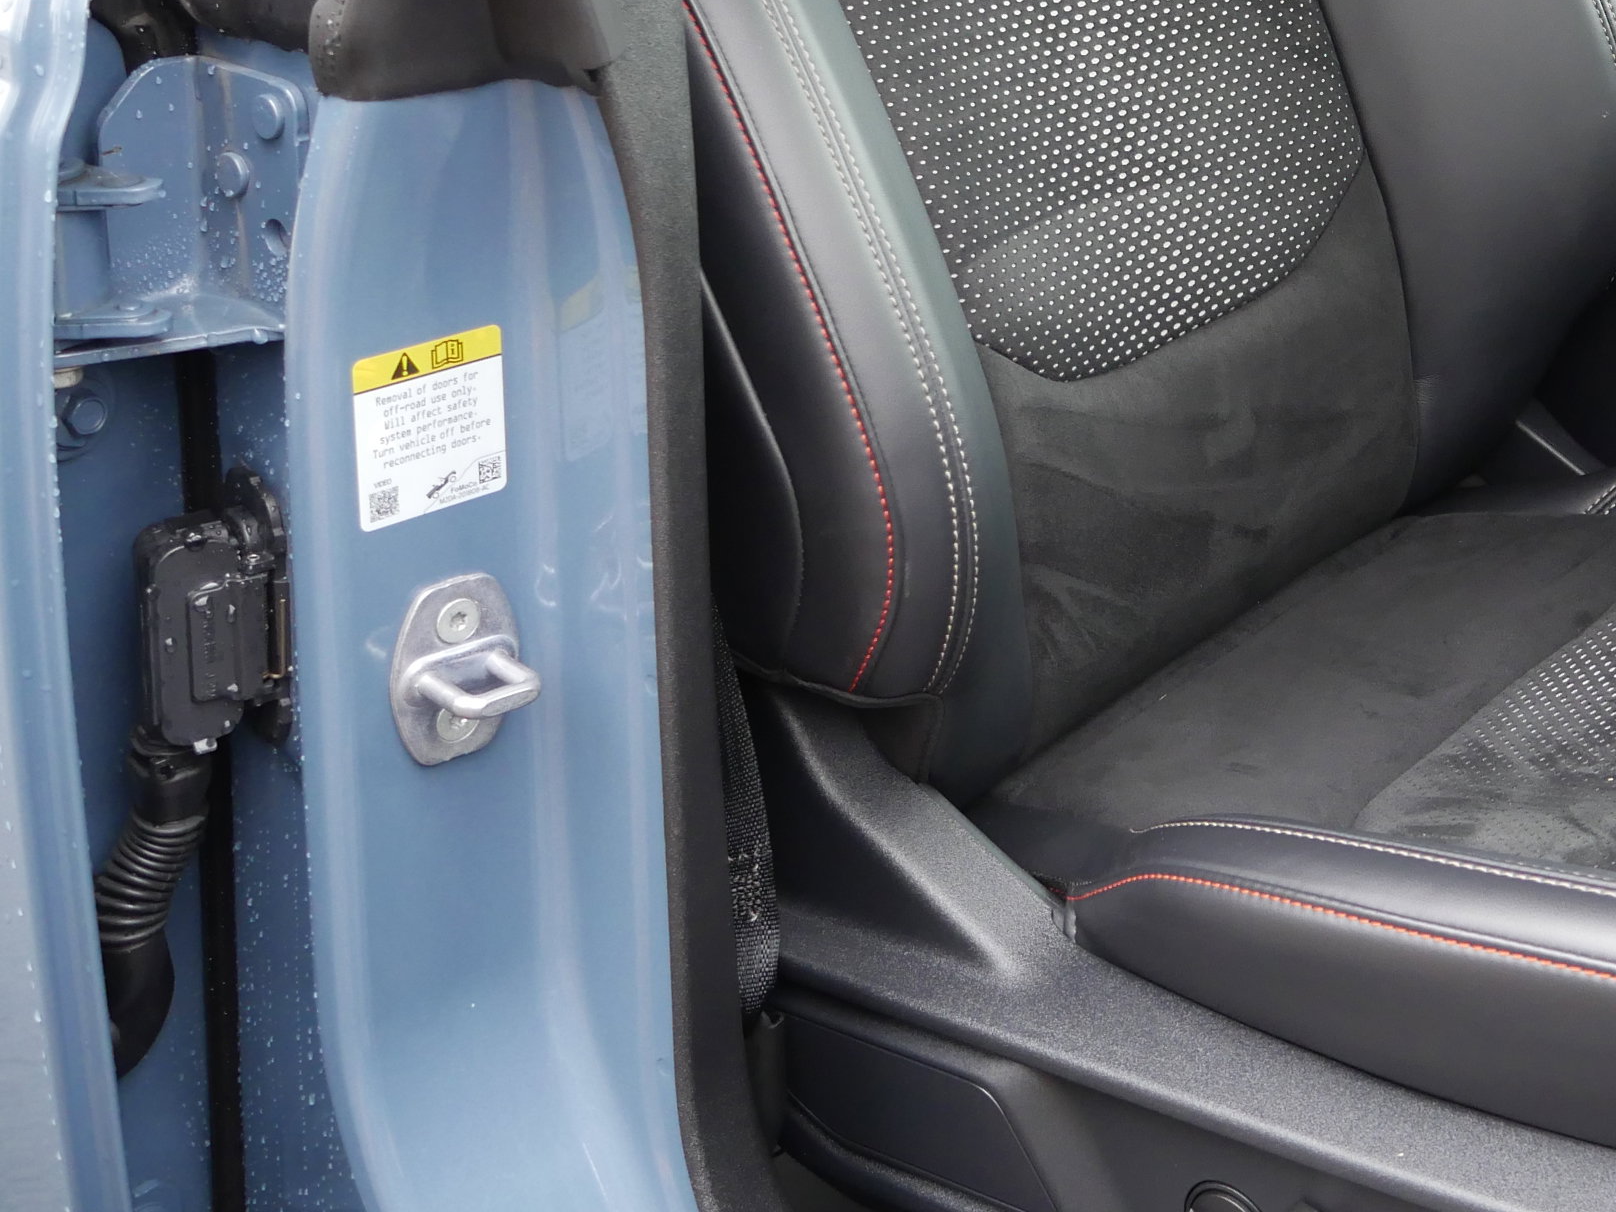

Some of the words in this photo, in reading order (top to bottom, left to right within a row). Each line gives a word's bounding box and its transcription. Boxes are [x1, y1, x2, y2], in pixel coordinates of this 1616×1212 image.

[375, 388, 412, 406] Removal
[417, 384, 426, 395] of
[432, 377, 458, 391] doors
[464, 371, 478, 382] for
[384, 397, 426, 417] off-road
[431, 393, 447, 404] use
[451, 386, 476, 398] only.
[380, 429, 412, 445] system
[417, 410, 477, 434] performance.
[384, 416, 405, 430] Will
[411, 406, 442, 423] affect
[447, 397, 478, 412] safety
[373, 447, 395, 459] Turn
[400, 434, 436, 451] vehicle
[440, 427, 455, 439] off
[460, 418, 491, 433] before
[383, 444, 447, 469] reconnecting
[451, 434, 481, 449] doors.
[373, 478, 392, 489] VIDEO
